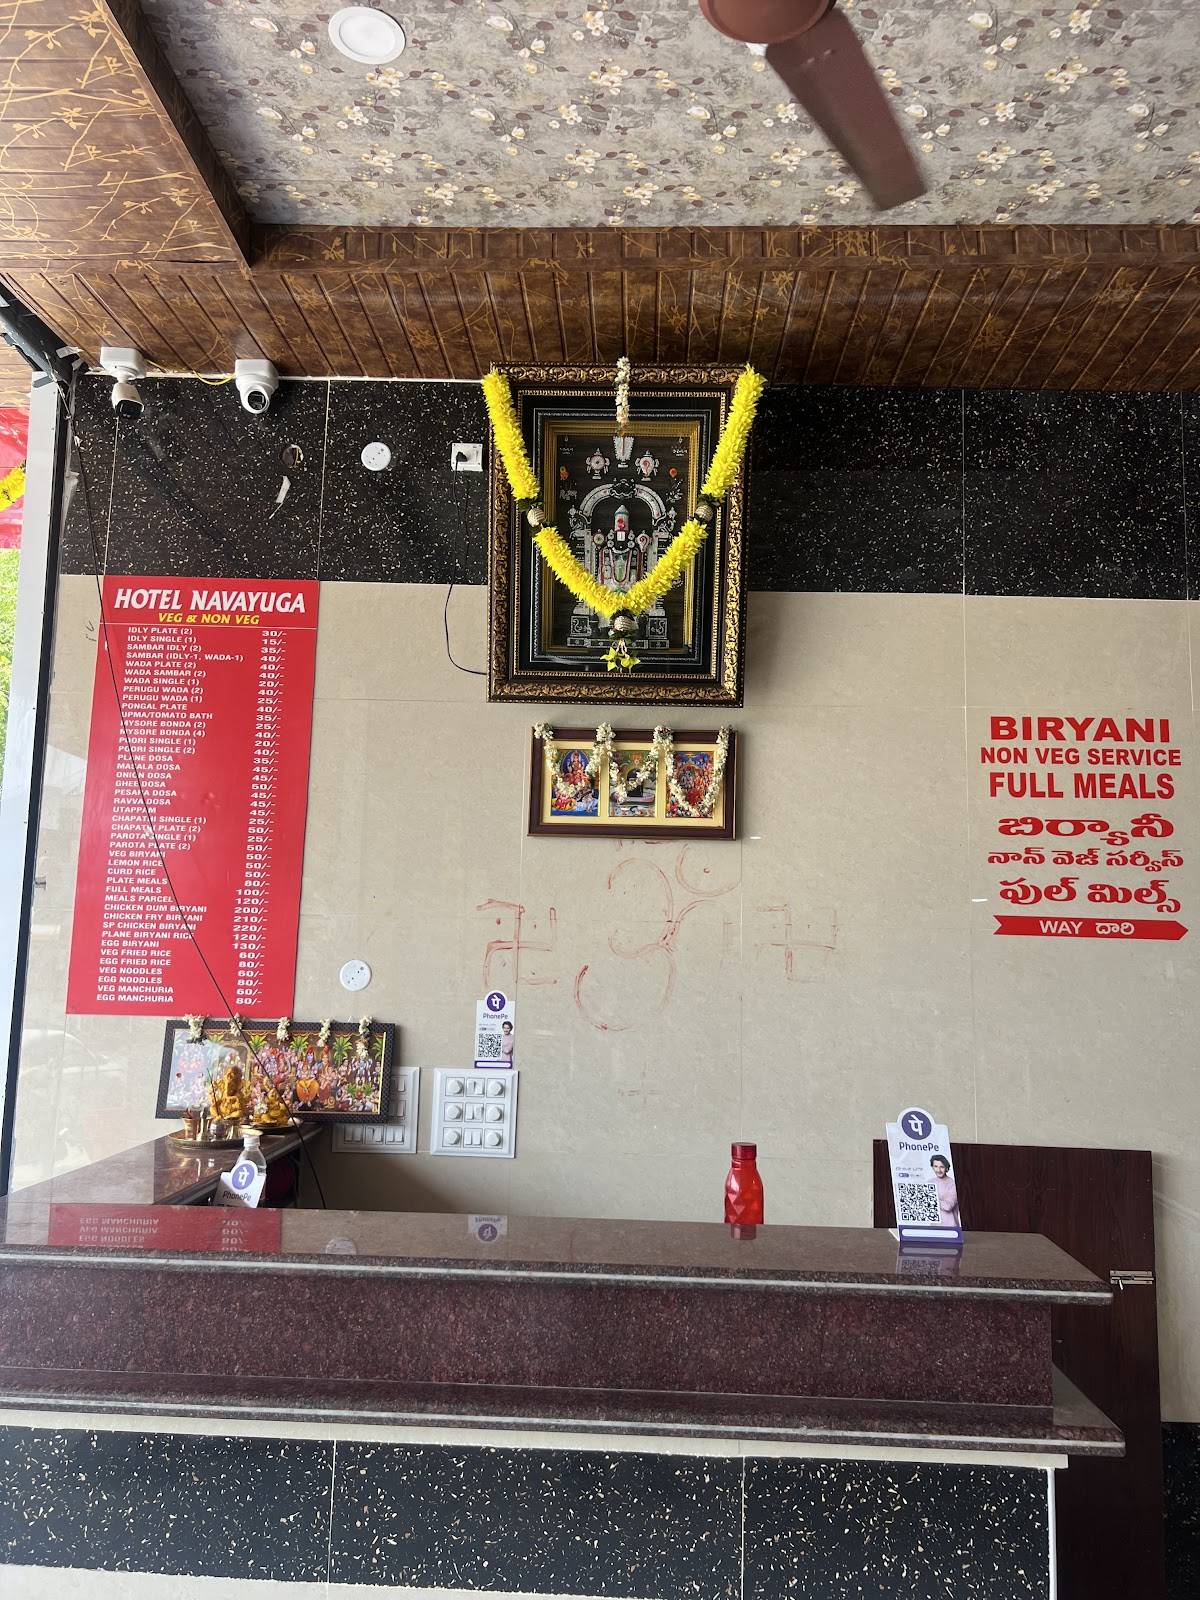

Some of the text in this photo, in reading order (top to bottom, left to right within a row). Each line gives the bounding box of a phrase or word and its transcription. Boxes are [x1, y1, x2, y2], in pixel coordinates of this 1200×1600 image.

[114, 588, 306, 613] HOTEL NAVAYUGA
[158, 612, 260, 625] VEG & NON VEG
[193, 670, 206, 678] (2)
[121, 711, 187, 719] UPMA/TOMATO
[256, 714, 281, 722] 35/-
[990, 716, 1170, 742] BIRYANI
[981, 747, 1182, 766] NON VEG SERVICE
[989, 772, 1175, 799] FULL MEALS
[158, 824, 186, 832] PLATE
[247, 835, 273, 843] 25/-
[987, 847, 1046, 865] నాన్
[135, 868, 156, 876] RICE
[233, 924, 267, 932] 220/-
[1039, 920, 1135, 935] WAY దారి
[101, 939, 120, 947] EGG
[100, 948, 119, 956] VEG
[119, 967, 163, 975] NOODLES
[119, 976, 162, 984] NOODLES
[117, 994, 174, 1002] MANCHURIA
[899, 1141, 939, 1152] PhonePe
[222, 1190, 252, 1201] PhonePe
